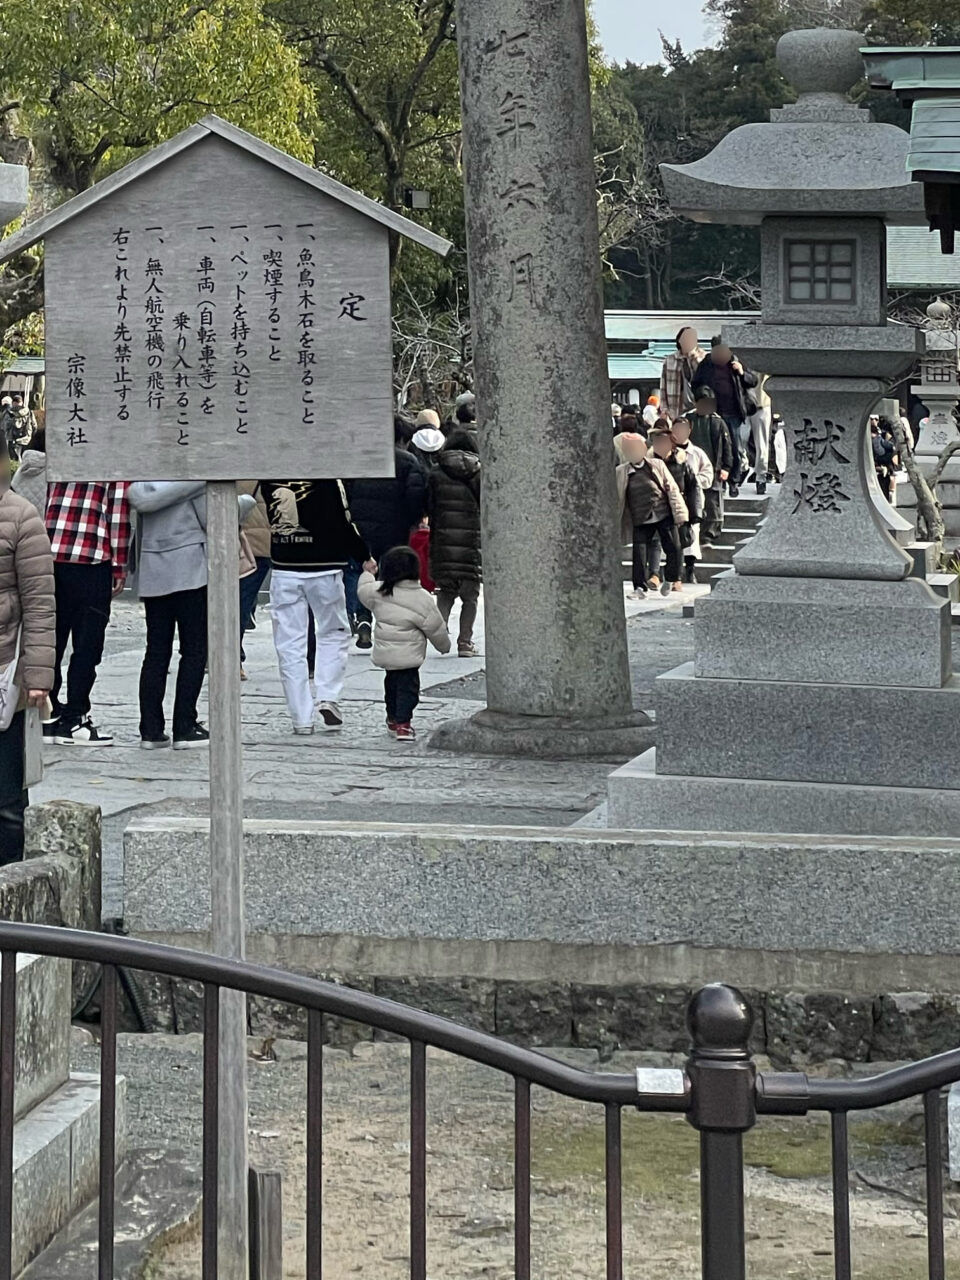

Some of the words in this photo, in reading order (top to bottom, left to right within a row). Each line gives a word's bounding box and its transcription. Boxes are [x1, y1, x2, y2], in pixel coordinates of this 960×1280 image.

[112, 226, 133, 421] 右これより先禁止する
[262, 223, 284, 362] 一、喫煙すること
[337, 291, 368, 322] 定
[65, 352, 89, 447] 宗像大社
[171, 311, 192, 446] 乗り入れること
[791, 417, 851, 515] 献燈
